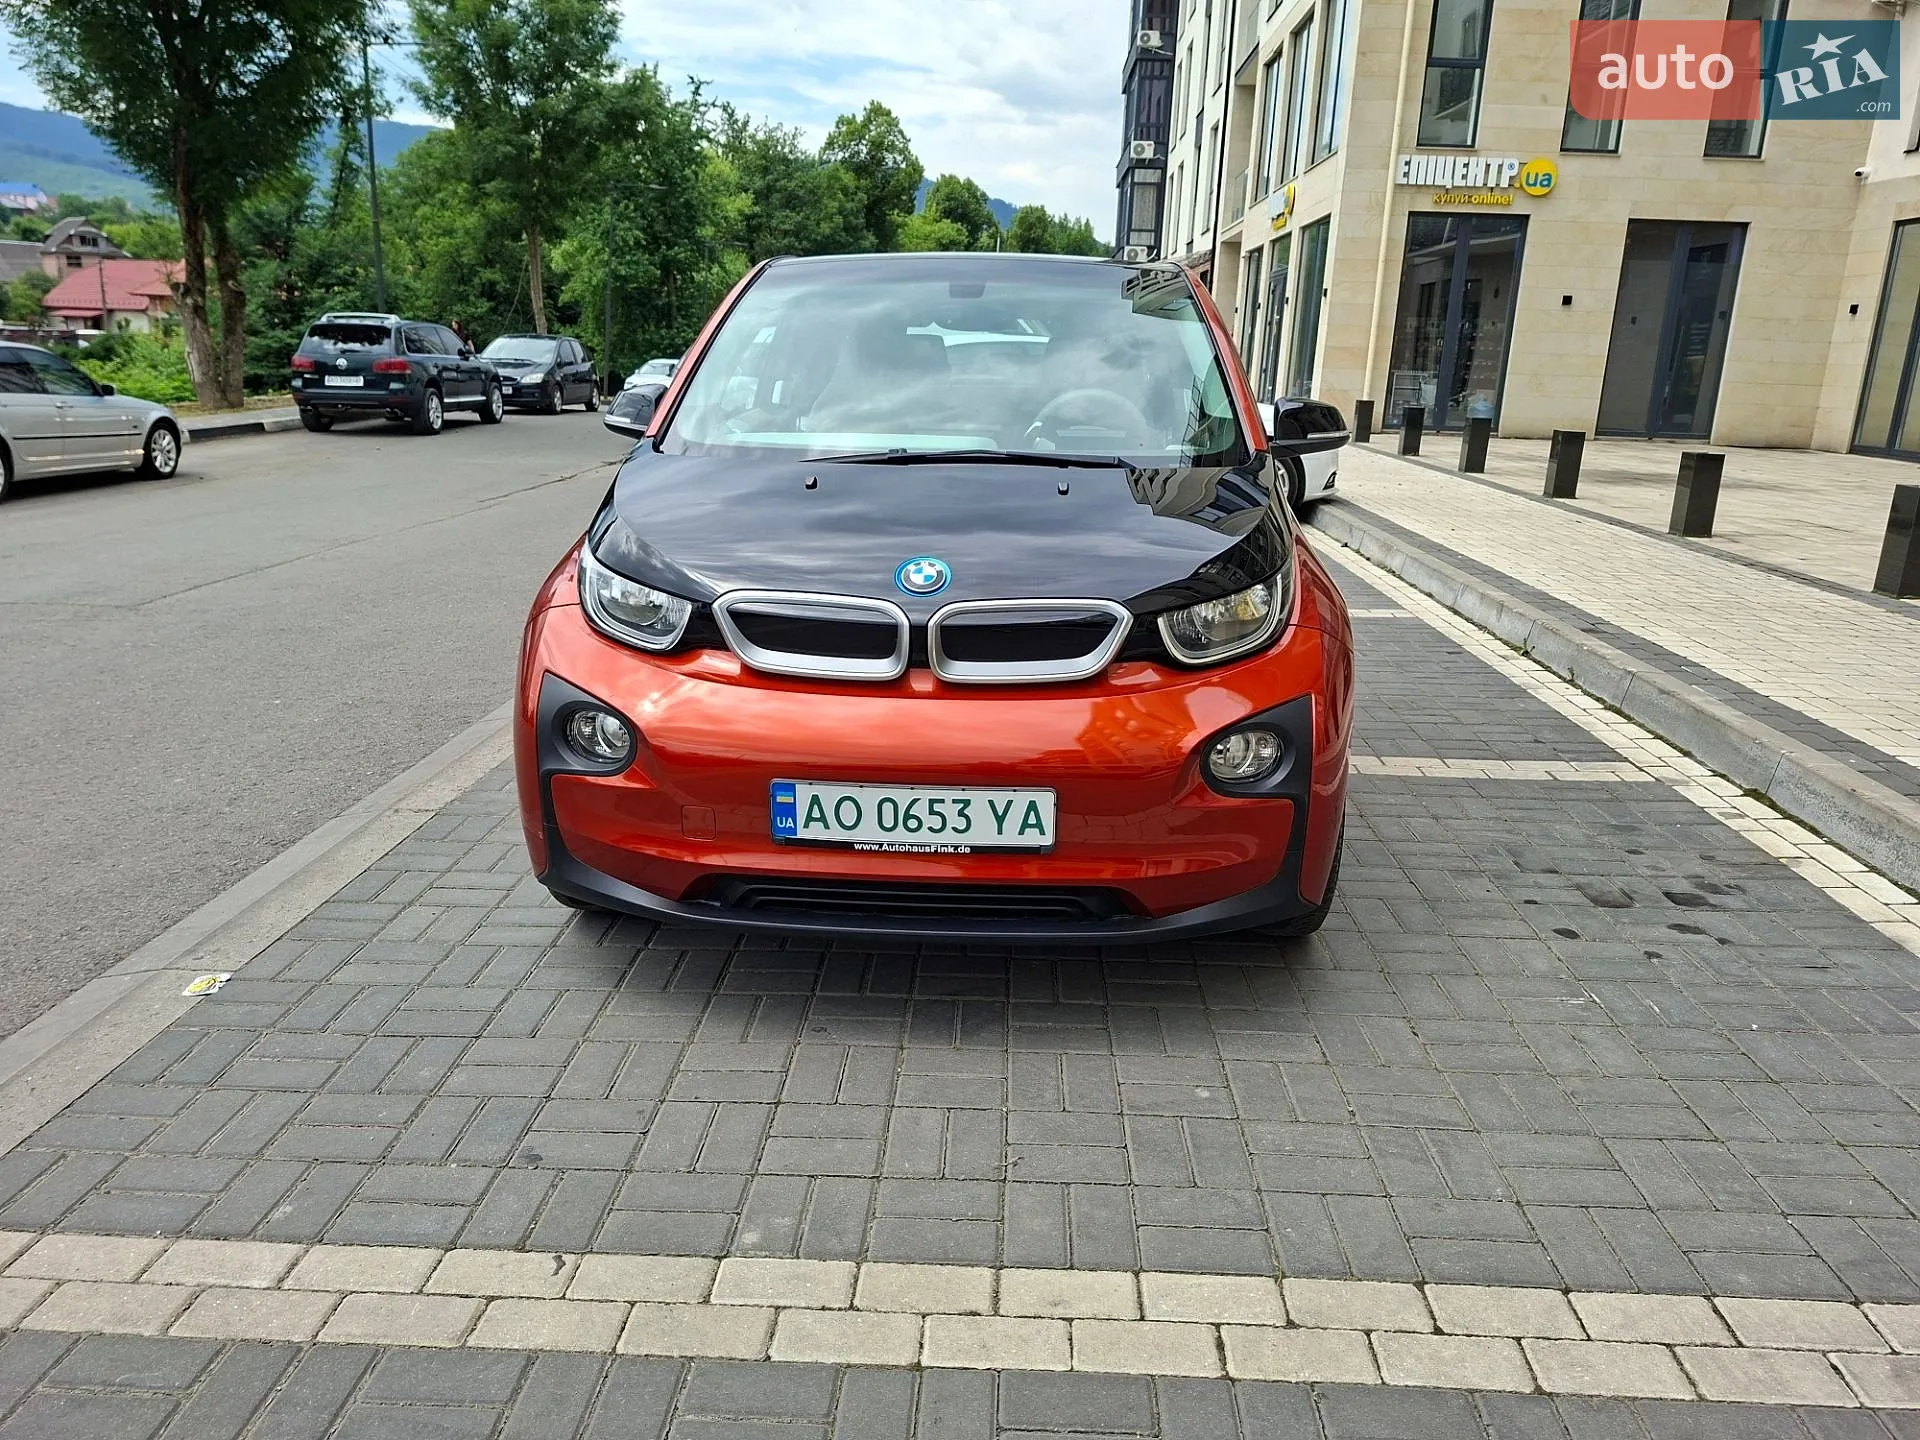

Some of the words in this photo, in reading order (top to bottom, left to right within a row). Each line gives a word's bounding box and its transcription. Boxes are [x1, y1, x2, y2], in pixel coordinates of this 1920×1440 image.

[1471, 192, 1513, 206] online!
[802, 793, 863, 831] AO
[877, 796, 973, 834] 0653
[987, 799, 1046, 836] YA
[776, 816, 795, 829] UA
